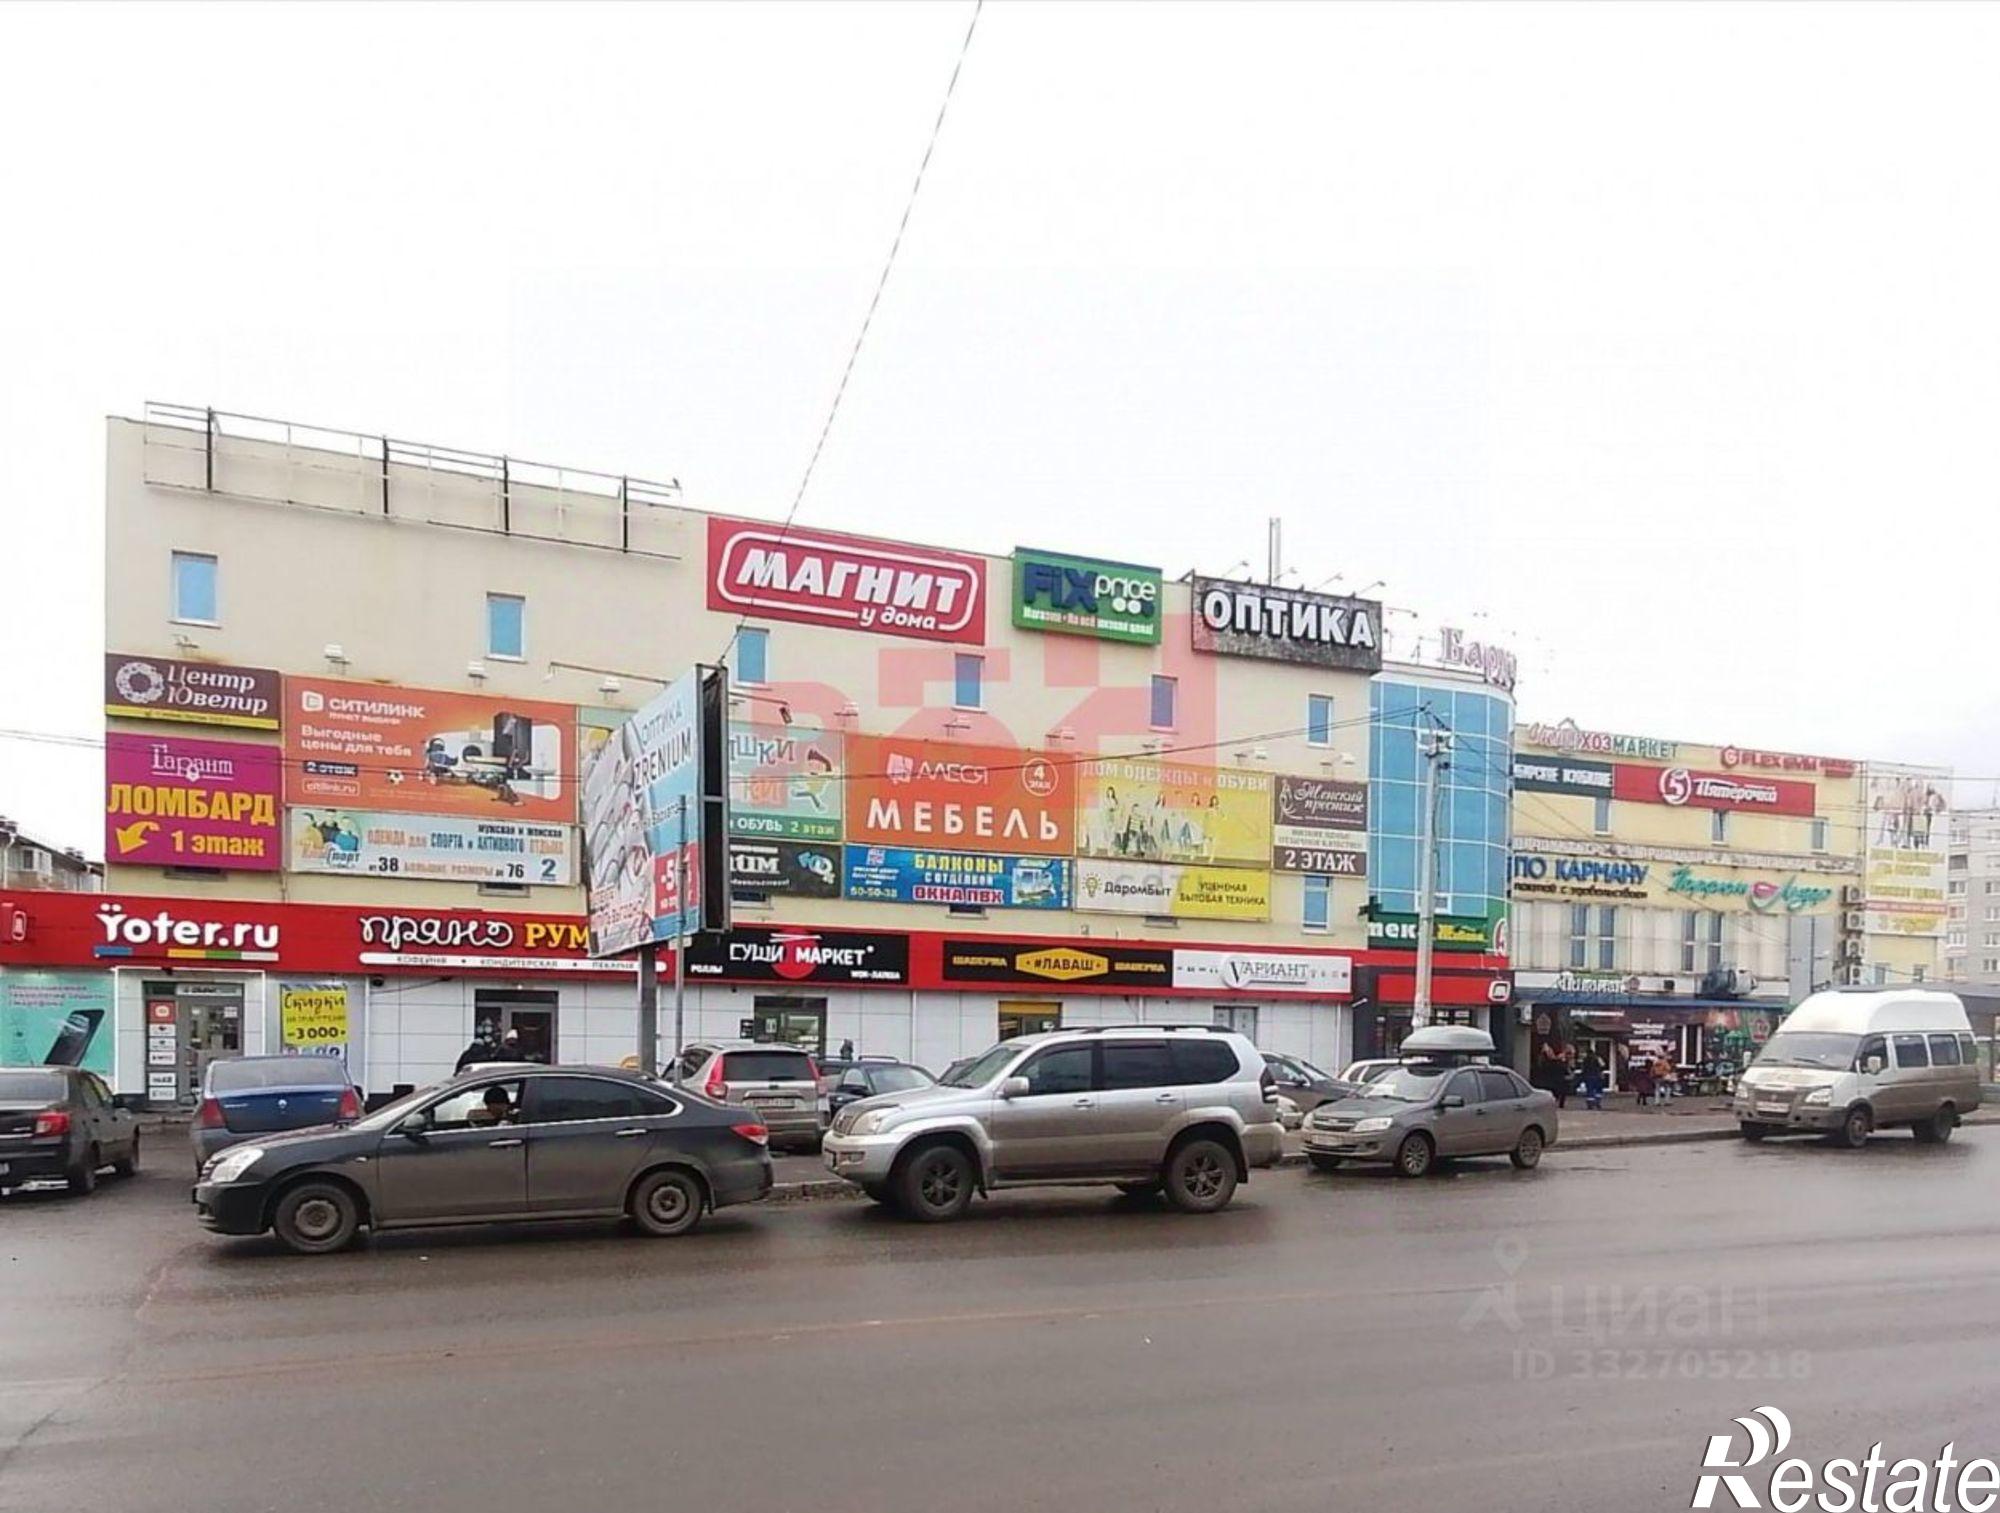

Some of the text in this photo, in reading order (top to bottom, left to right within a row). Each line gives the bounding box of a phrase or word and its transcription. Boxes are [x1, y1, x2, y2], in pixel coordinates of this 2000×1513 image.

[736, 548, 963, 613] МАГНИТ
[1024, 562, 1156, 613] FIX price
[860, 606, 936, 630] у дома
[1203, 590, 1375, 650] ОПТИКА
[168, 665, 255, 693] Центр
[168, 686, 268, 715] Ювелир
[329, 697, 426, 719] СИТИЛИНК
[301, 724, 382, 742] Выгодные
[301, 740, 412, 757] цены для тебя
[151, 743, 234, 779] Гарант
[1033, 764, 1045, 778] 4
[1217, 774, 1269, 791] ОБУВИ
[107, 783, 276, 826] ЛОМБАРД
[737, 817, 783, 832] ОБУВЬ
[790, 821, 800, 833] 2
[867, 798, 1059, 840] МЕБЕЛЬ
[171, 830, 265, 857] 1 этаж
[430, 832, 464, 849] СПОРТА
[378, 856, 399, 873] 38
[507, 863, 524, 878] 76
[540, 858, 556, 877] 2
[914, 852, 1004, 873] БАЛКОНЫ
[1285, 850, 1356, 872] 2 ЭТАЖ
[1514, 856, 1547, 879] ПО
[1555, 858, 1649, 885] КАРМАНУ
[914, 886, 1004, 904] ОКНА ПВХ
[1104, 881, 1172, 898] ДаромБыт
[1180, 892, 1266, 905] БЫТОВАЯ ТЕХНИКА
[524, 923, 589, 949] РУМ
[729, 942, 865, 966] СУШИ МАРКЕТ
[1034, 958, 1094, 971] #ЛАВАШ
